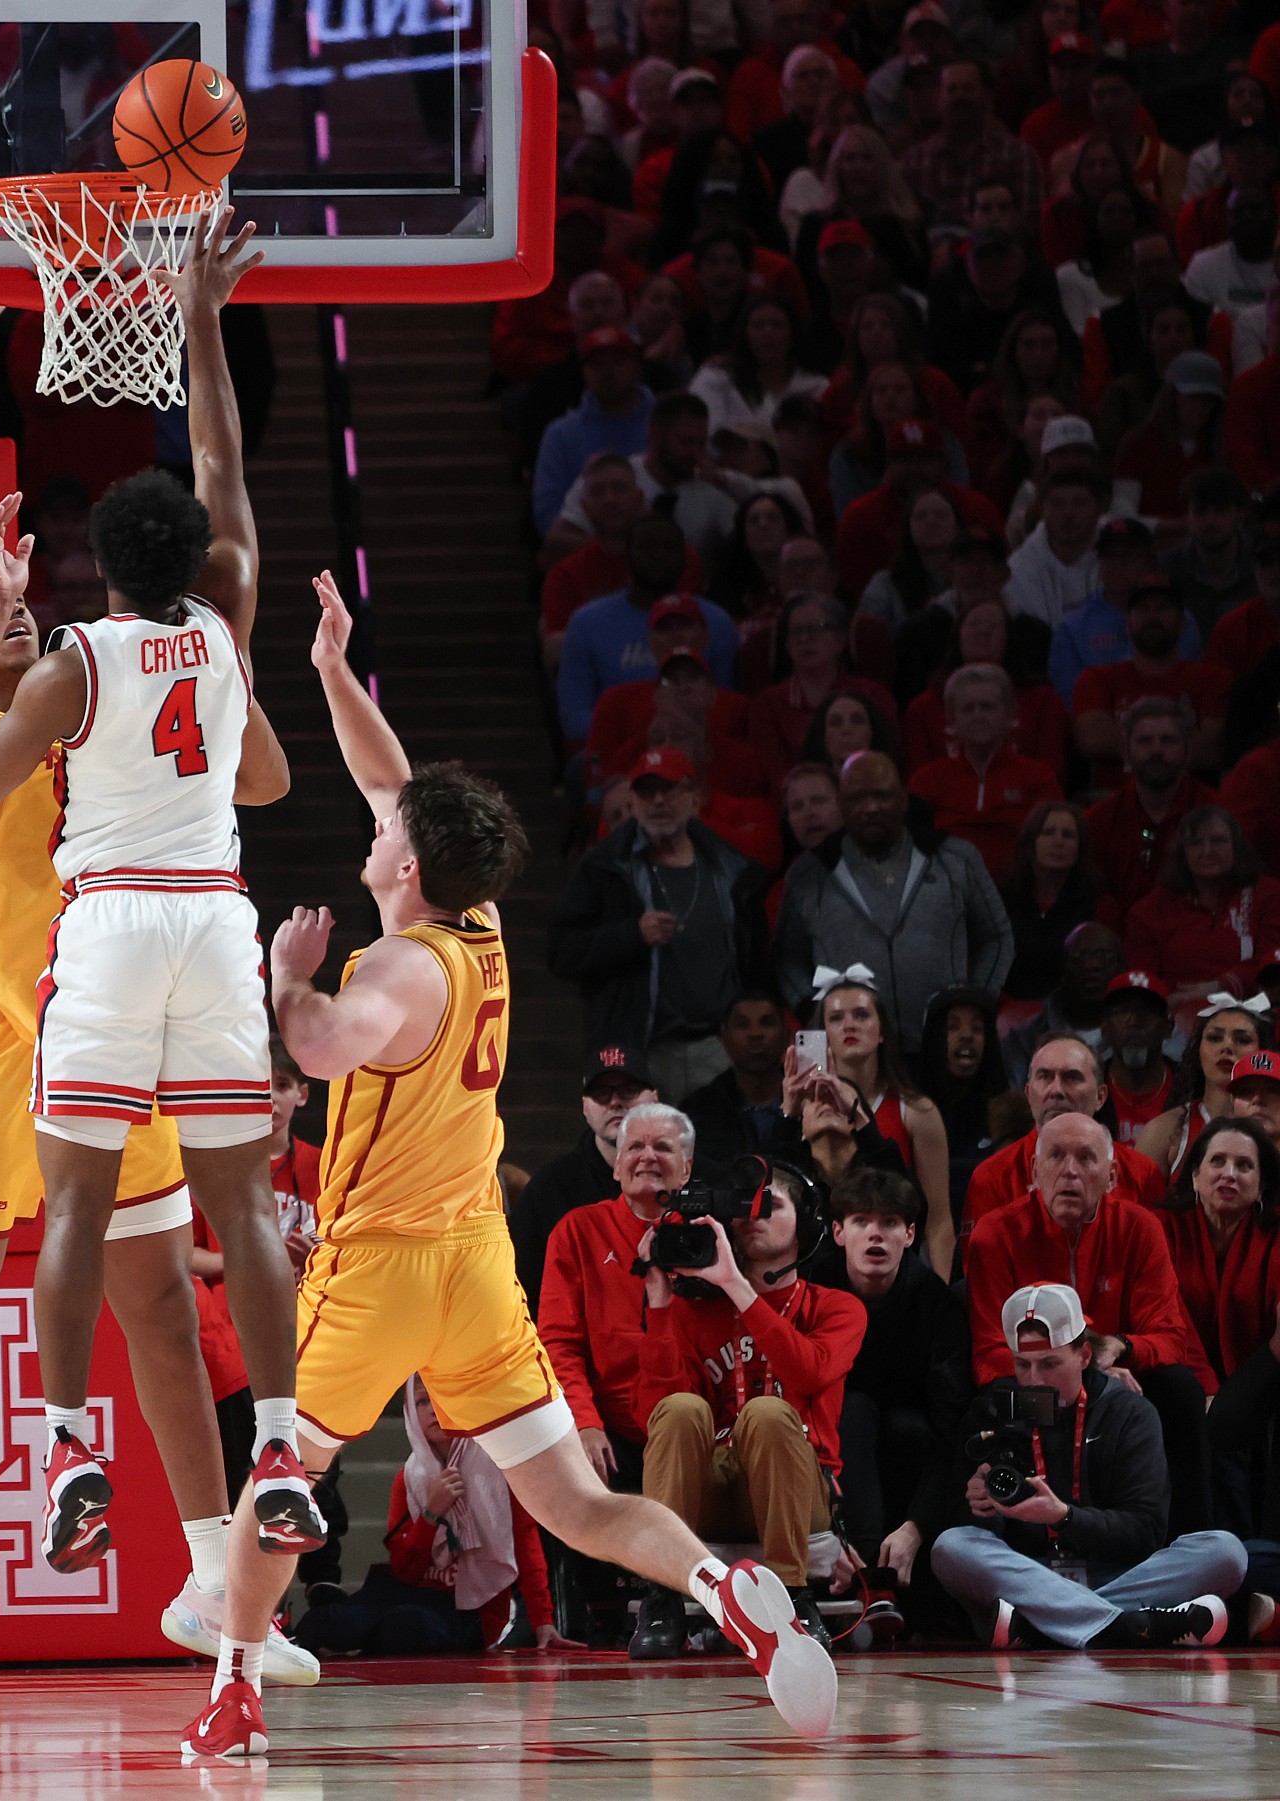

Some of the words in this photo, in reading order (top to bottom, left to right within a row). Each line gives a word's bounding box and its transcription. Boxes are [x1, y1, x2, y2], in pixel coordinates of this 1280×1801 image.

[140, 629, 210, 675] CRYER
[151, 676, 209, 778] 4
[477, 952, 504, 990] HE
